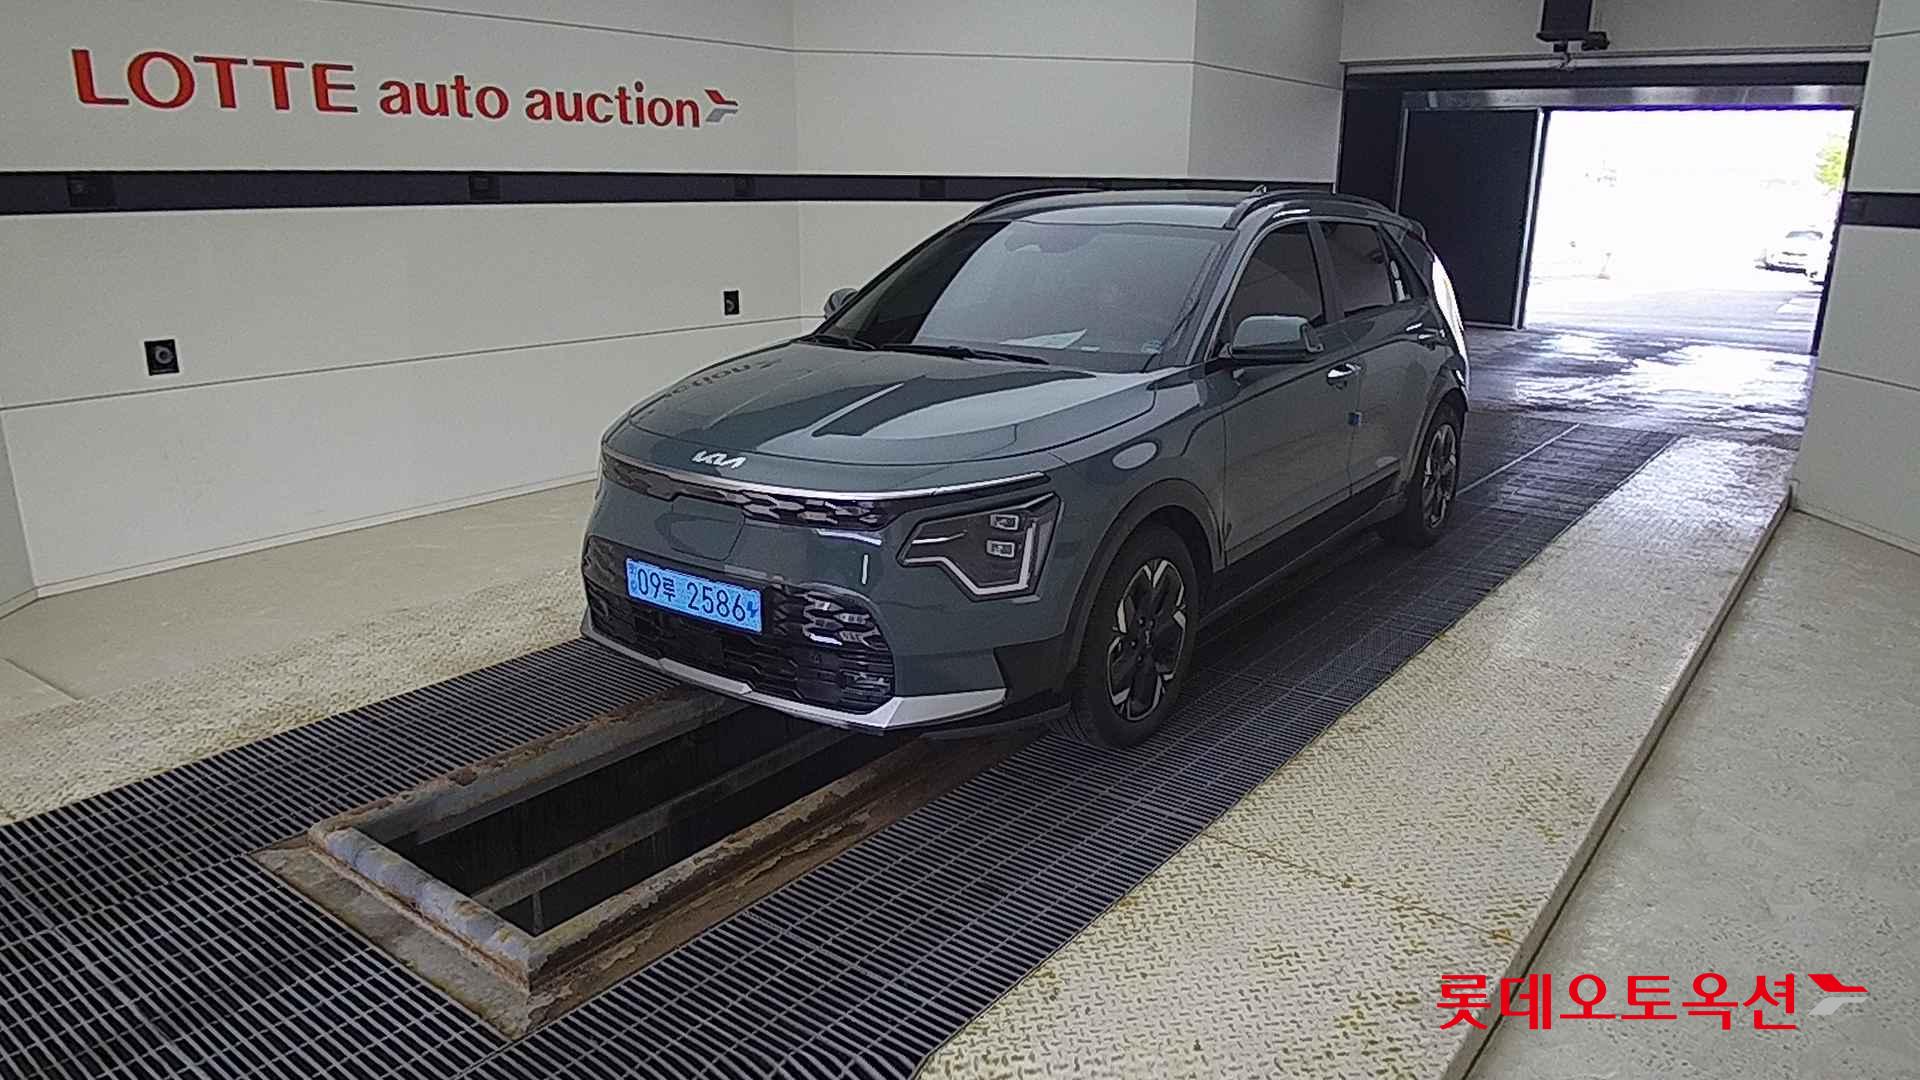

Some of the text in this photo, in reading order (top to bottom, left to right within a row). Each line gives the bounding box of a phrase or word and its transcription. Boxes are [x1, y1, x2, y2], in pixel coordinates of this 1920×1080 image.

[71, 48, 701, 128] LOTTE auto auction
[637, 568, 746, 621] 09루 2586
